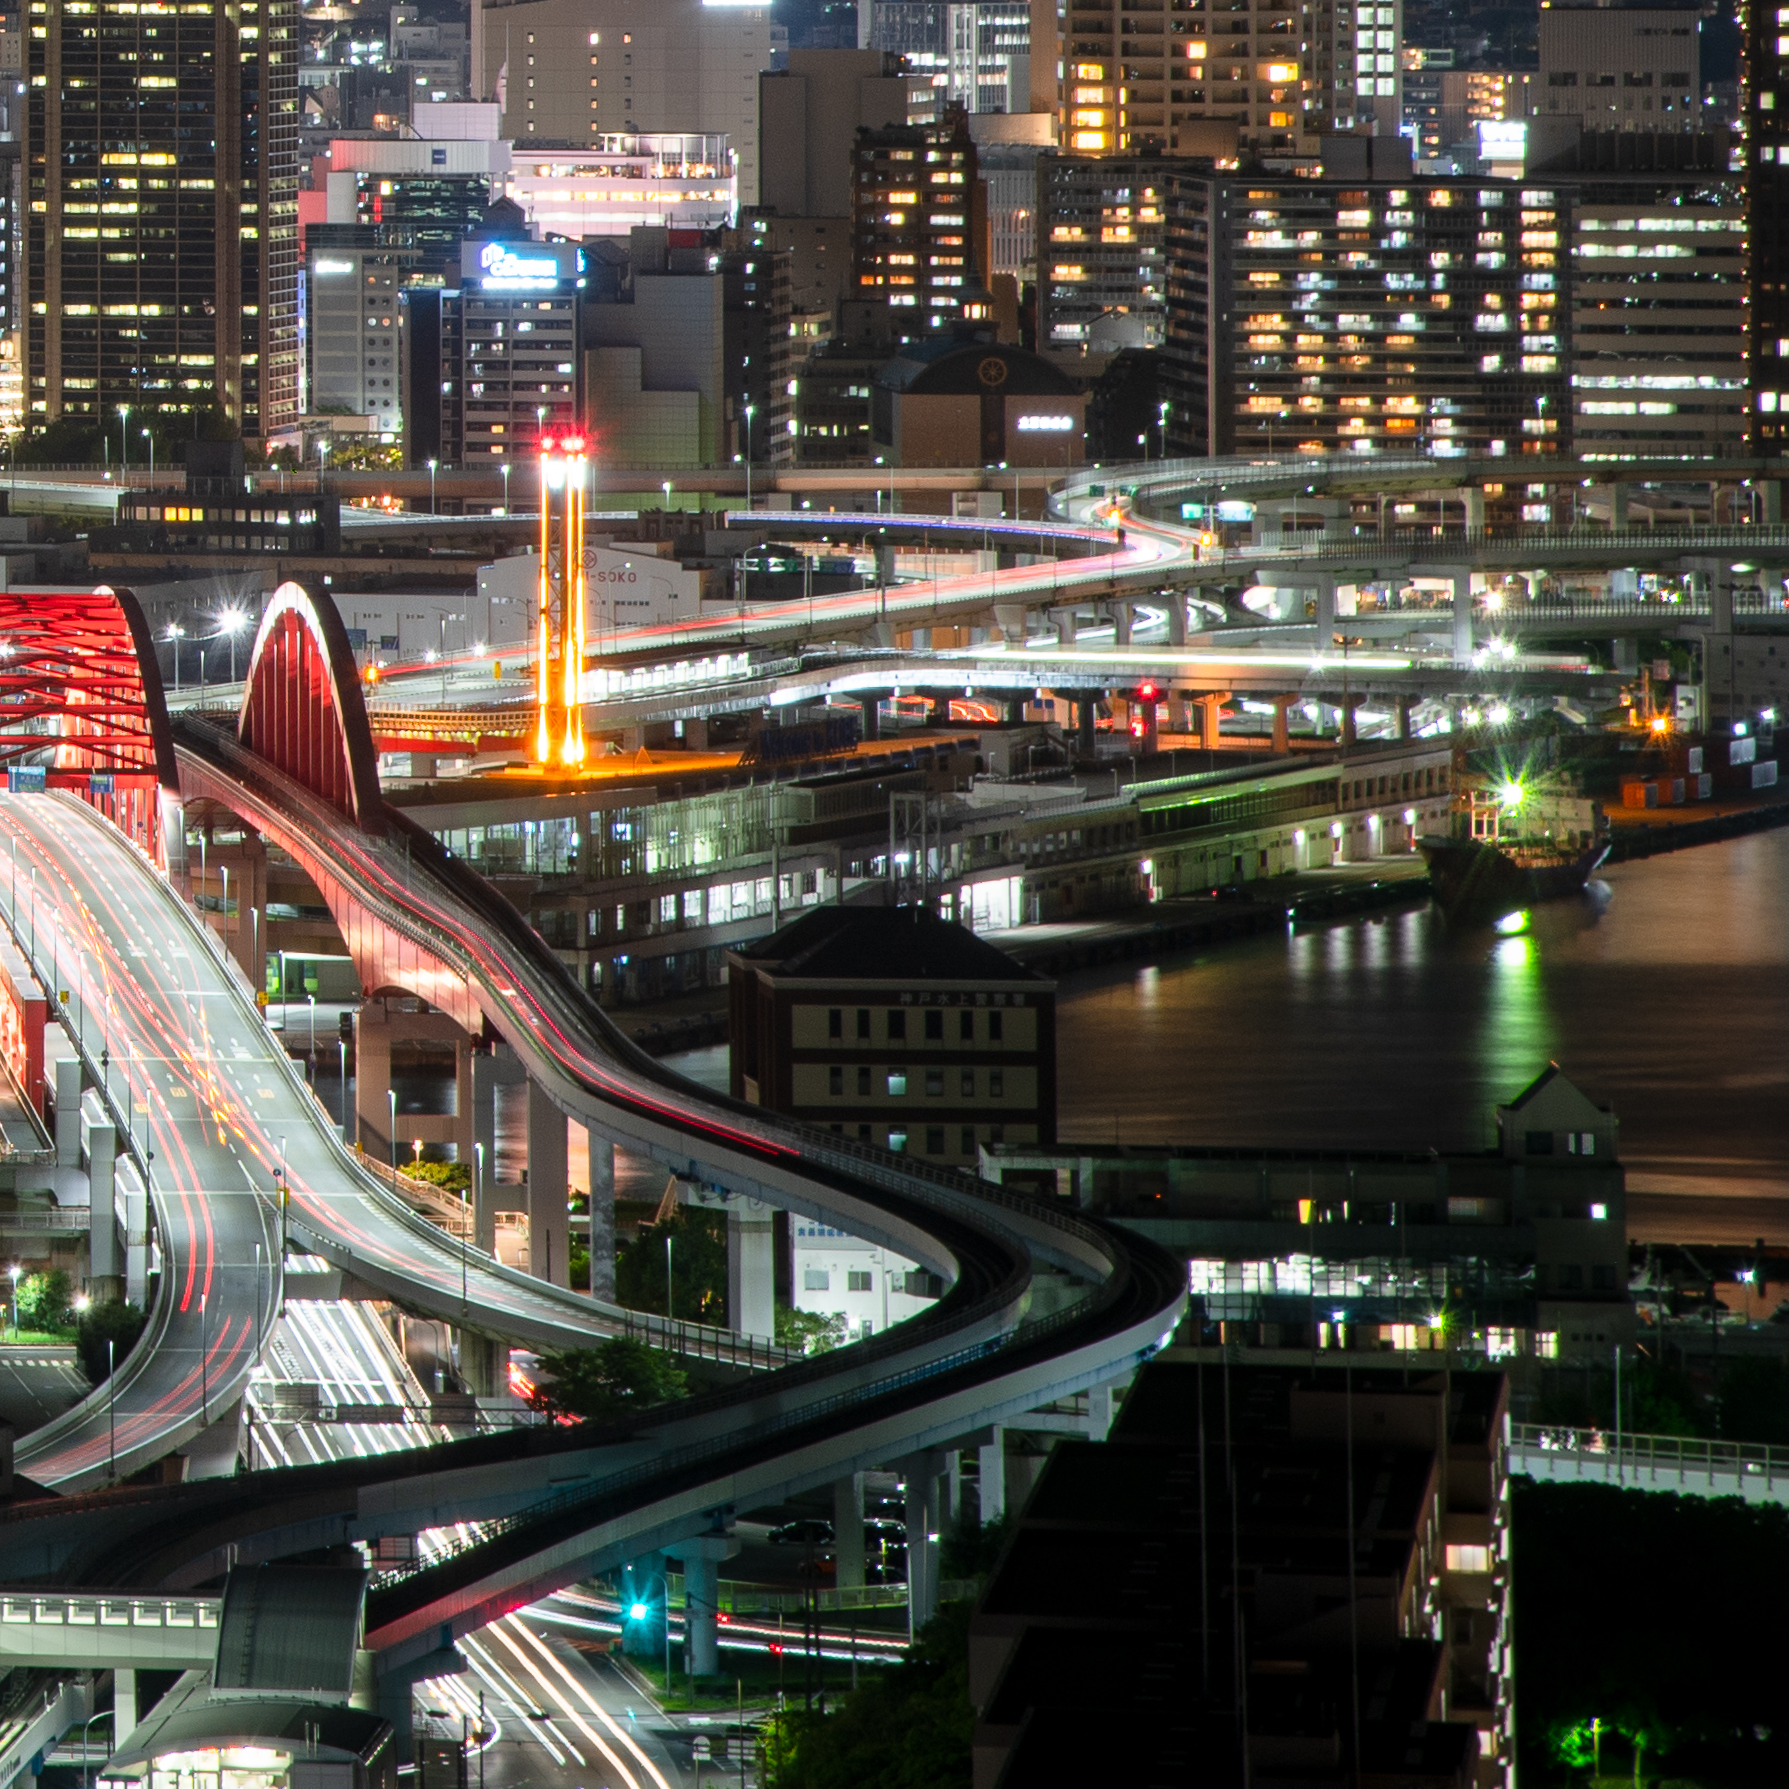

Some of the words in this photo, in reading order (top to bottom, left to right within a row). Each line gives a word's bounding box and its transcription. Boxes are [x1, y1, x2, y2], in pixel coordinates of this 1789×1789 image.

[900, 991, 1026, 1007] 神戸水上警察署
